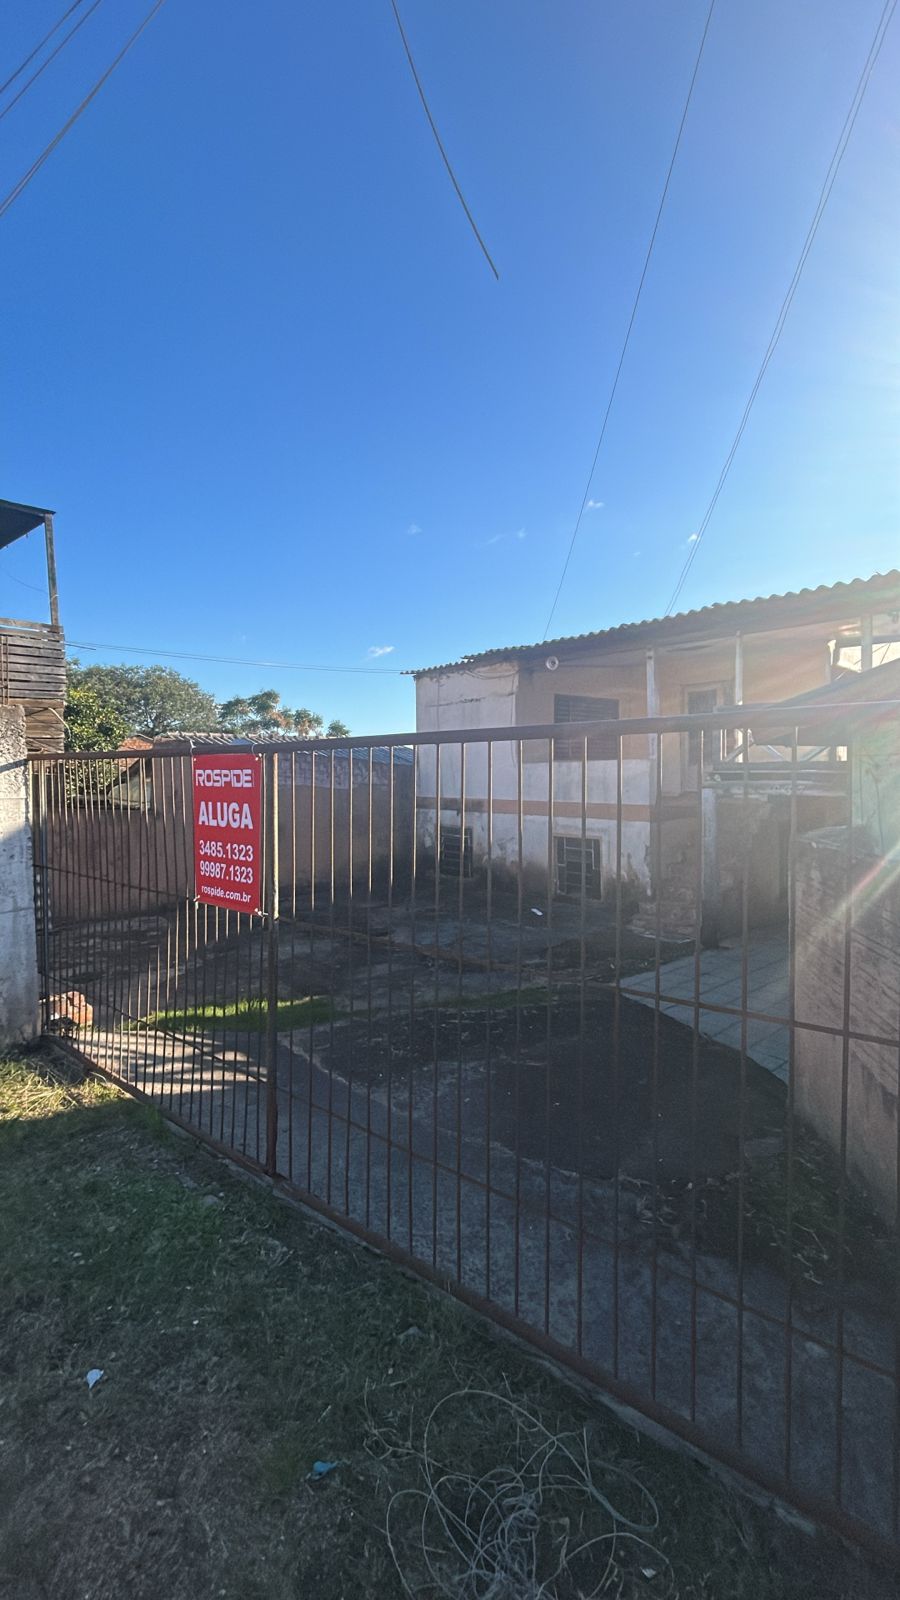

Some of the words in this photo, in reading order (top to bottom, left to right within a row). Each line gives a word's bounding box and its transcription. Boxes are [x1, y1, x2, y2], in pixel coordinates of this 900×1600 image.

[195, 769, 252, 788] ROSPIDE
[198, 801, 253, 830] ALUGA
[199, 840, 254, 862] 3485.1323
[199, 860, 253, 884] 99987.1323
[201, 885, 251, 903] rospide.com.br
